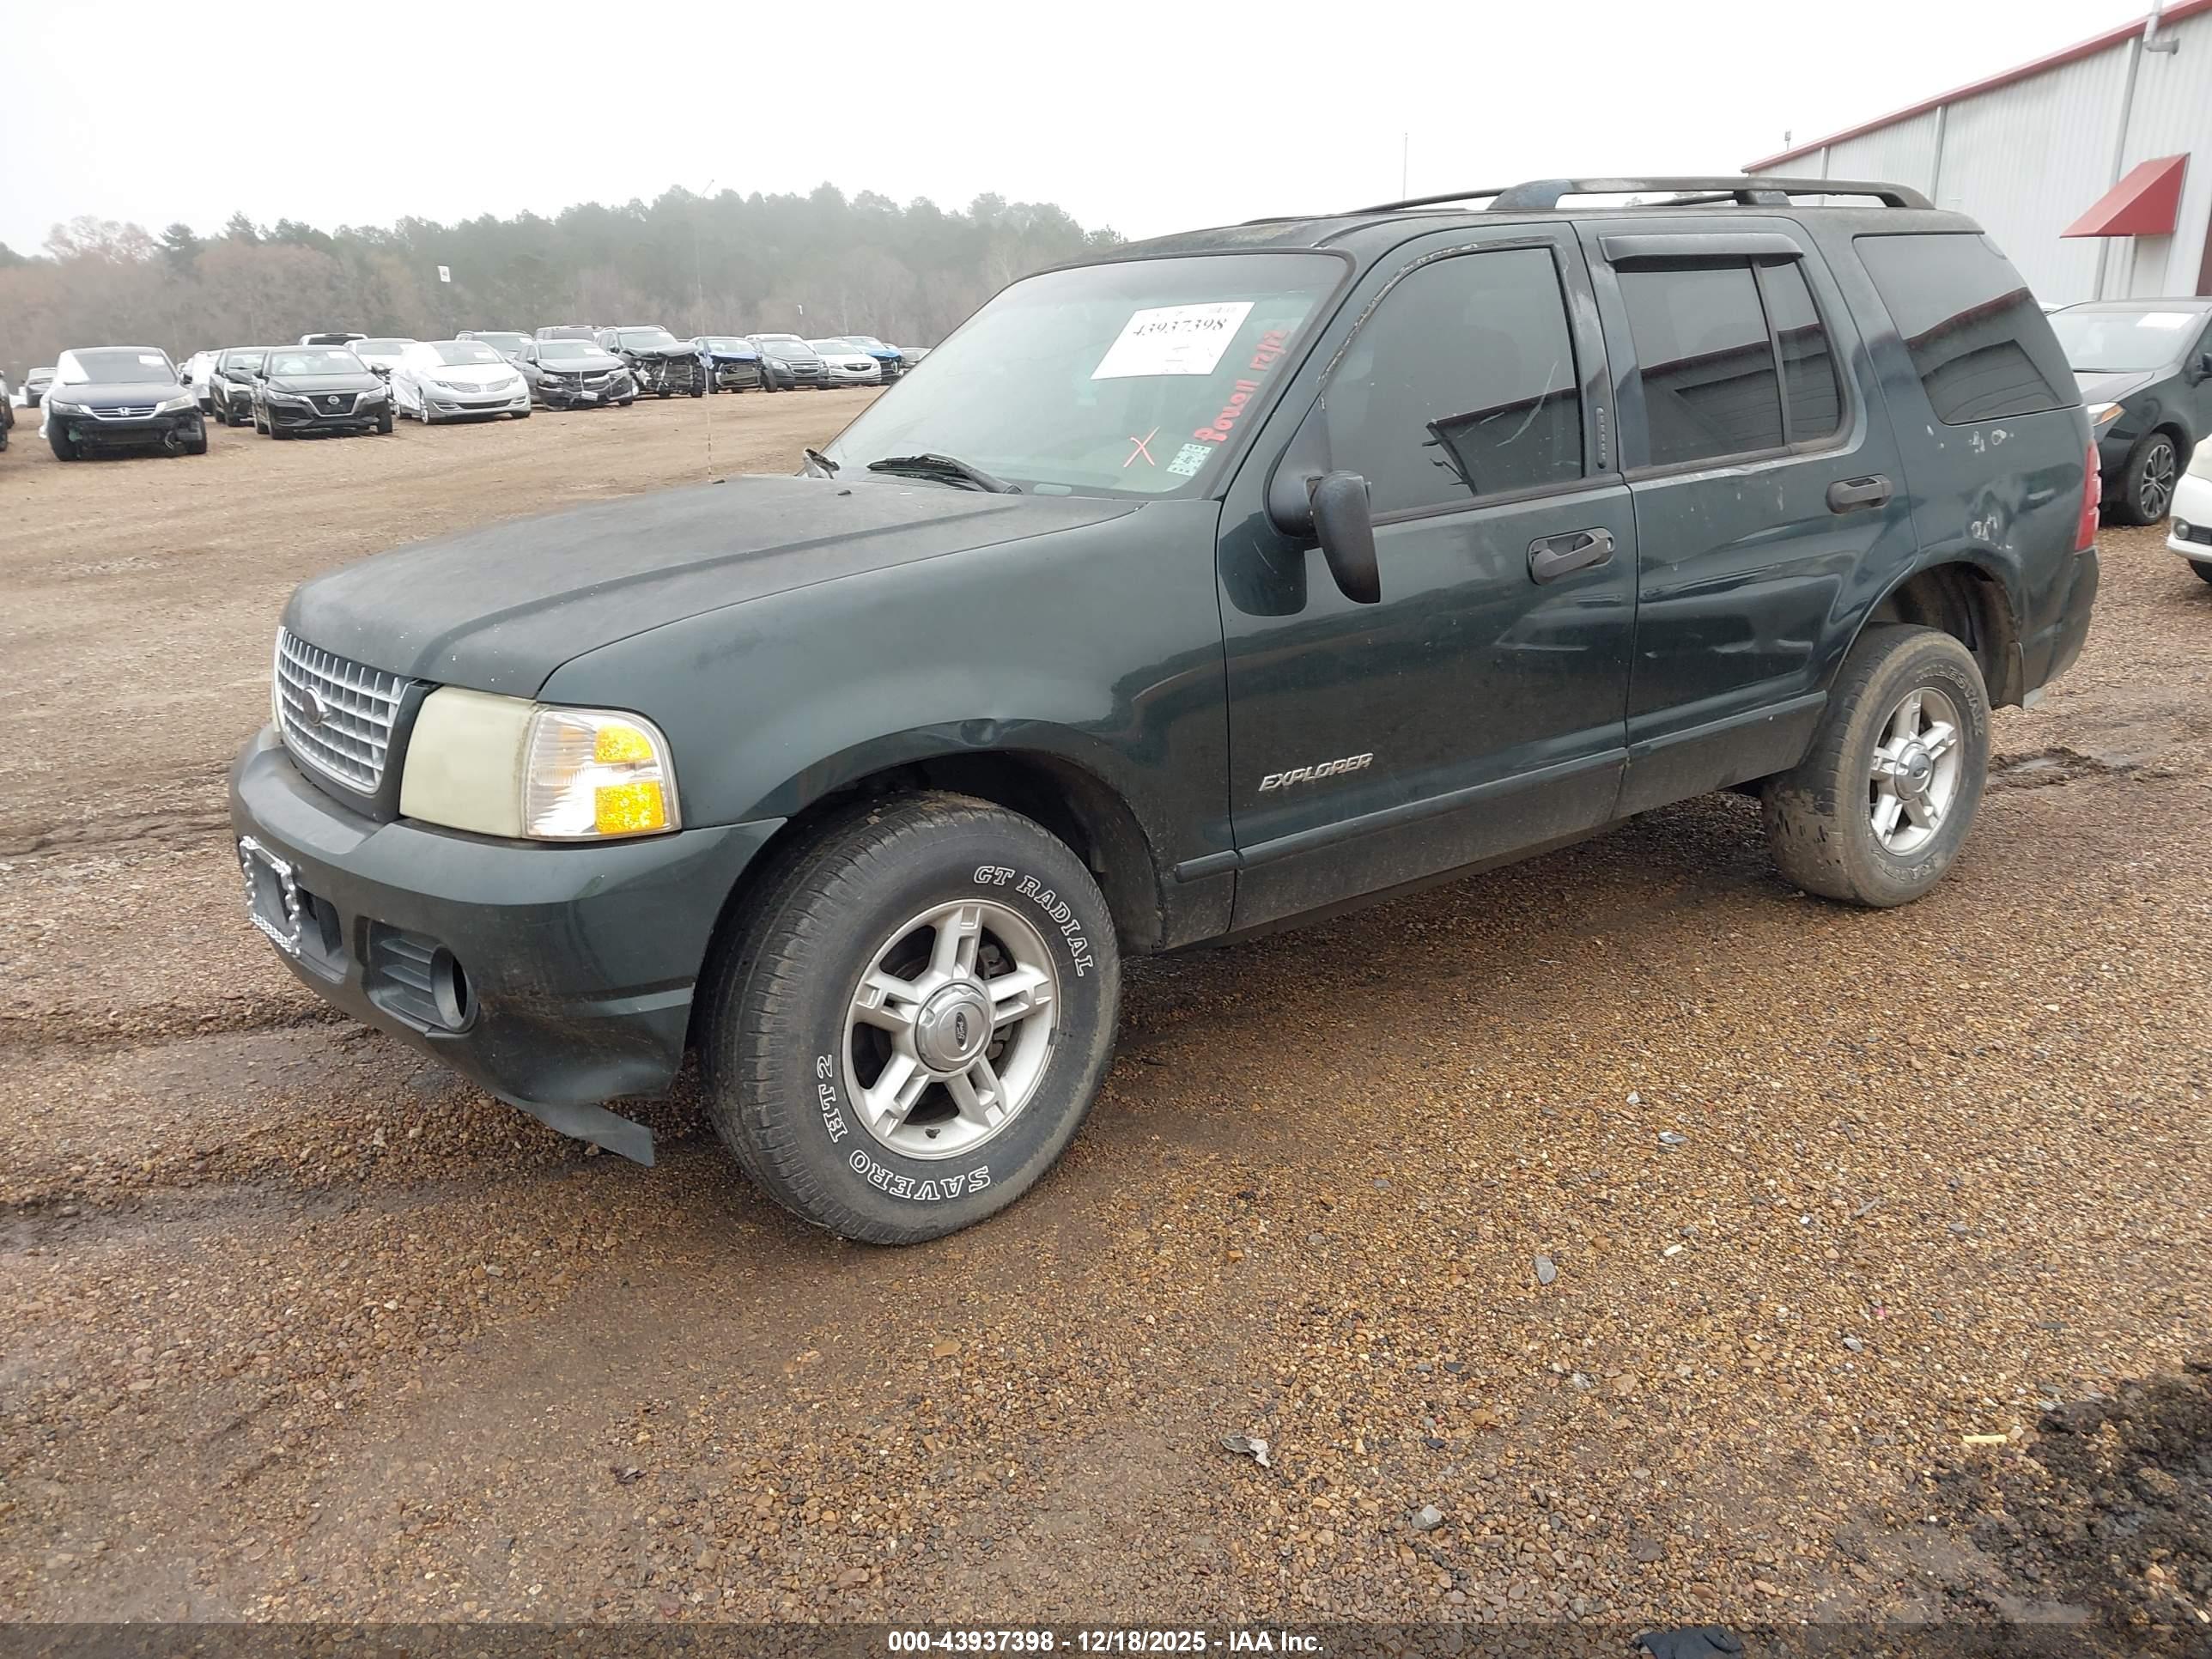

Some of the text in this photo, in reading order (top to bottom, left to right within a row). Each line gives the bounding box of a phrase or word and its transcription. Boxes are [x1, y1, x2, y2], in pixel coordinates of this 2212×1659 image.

[1133, 317, 1228, 337] 43937398
[1257, 752, 1375, 792] EXPLORER
[974, 866, 1097, 977] GT RADIAL
[817, 1054, 991, 1201] SAVERO HT2
